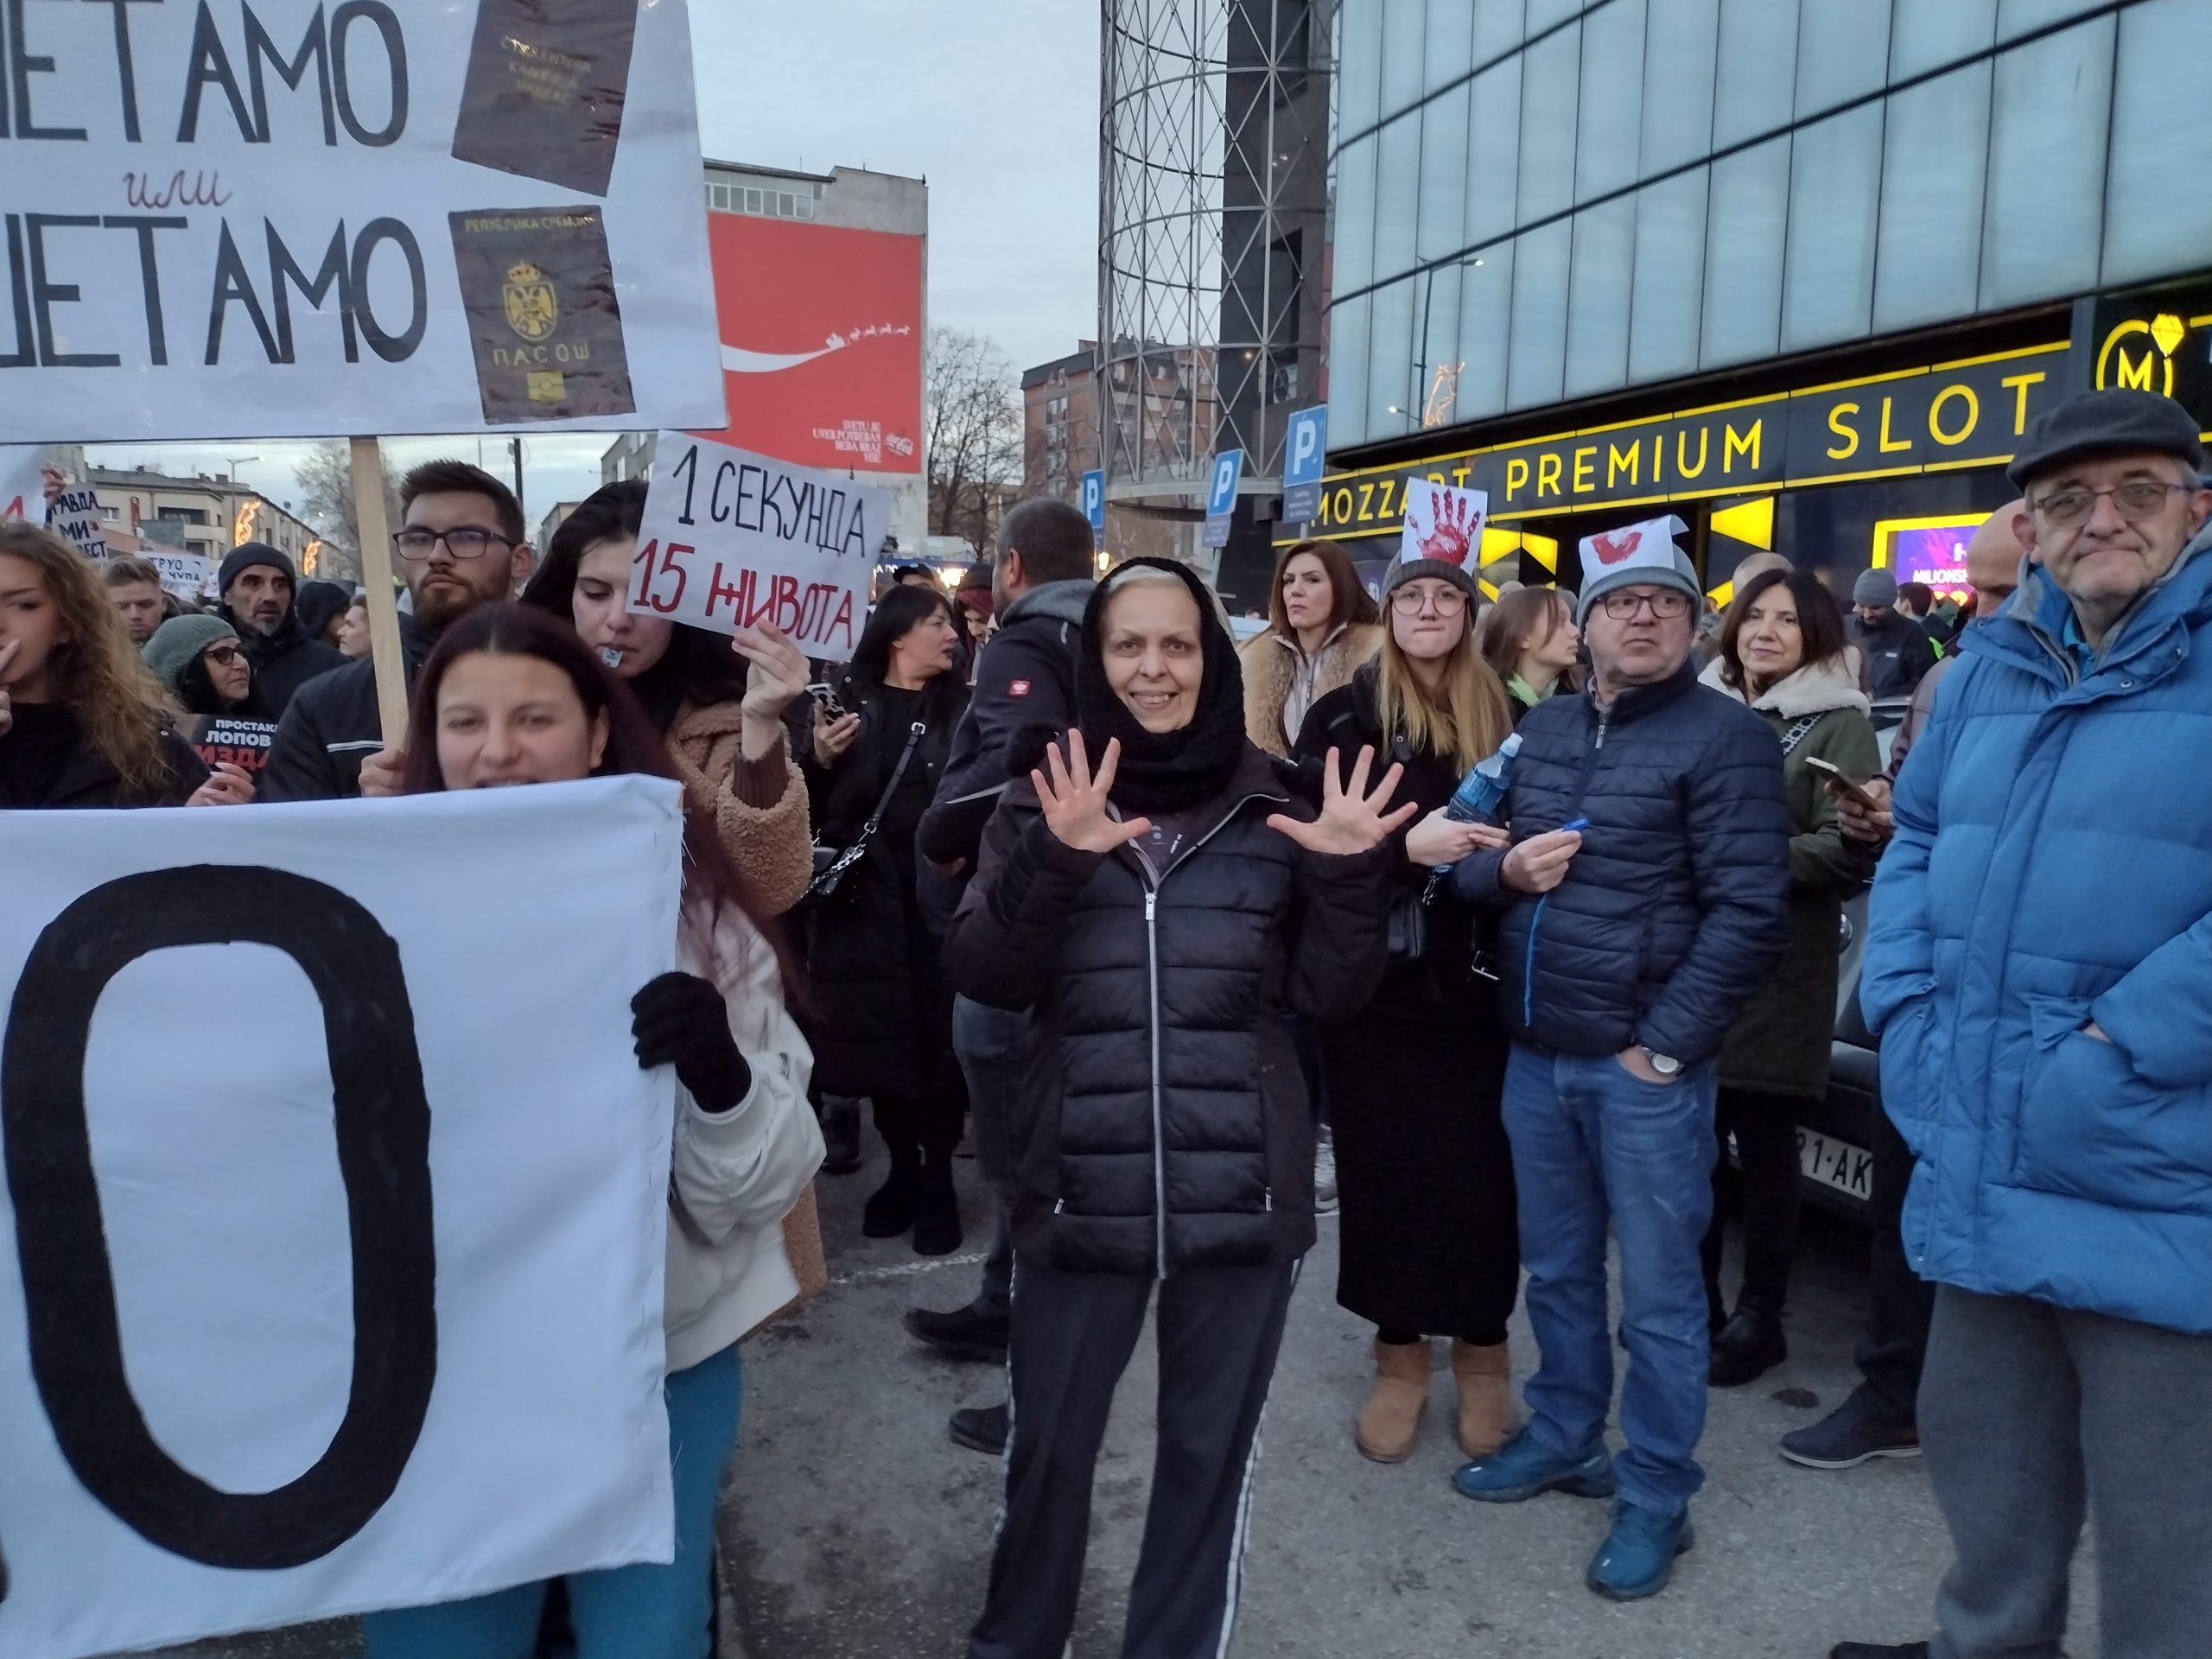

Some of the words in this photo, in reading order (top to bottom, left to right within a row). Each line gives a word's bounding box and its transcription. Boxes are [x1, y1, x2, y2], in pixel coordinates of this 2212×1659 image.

[0, 0, 409, 147] ЕТАМО
[122, 169, 232, 208] или
[465, 216, 539, 232] РЕПУБЛИКА
[493, 344, 590, 366] ПАСОШ
[1293, 419, 1317, 475] P
[1506, 417, 1762, 502] PREMIUM
[1826, 372, 2046, 460] SLOT
[672, 444, 698, 525] 1
[711, 461, 867, 558] СЕКУНДА
[1086, 478, 1099, 520] P
[1213, 460, 1233, 507] P
[59, 520, 90, 541] МИ
[633, 538, 695, 613] 15
[705, 562, 852, 649] ЖИВОТА
